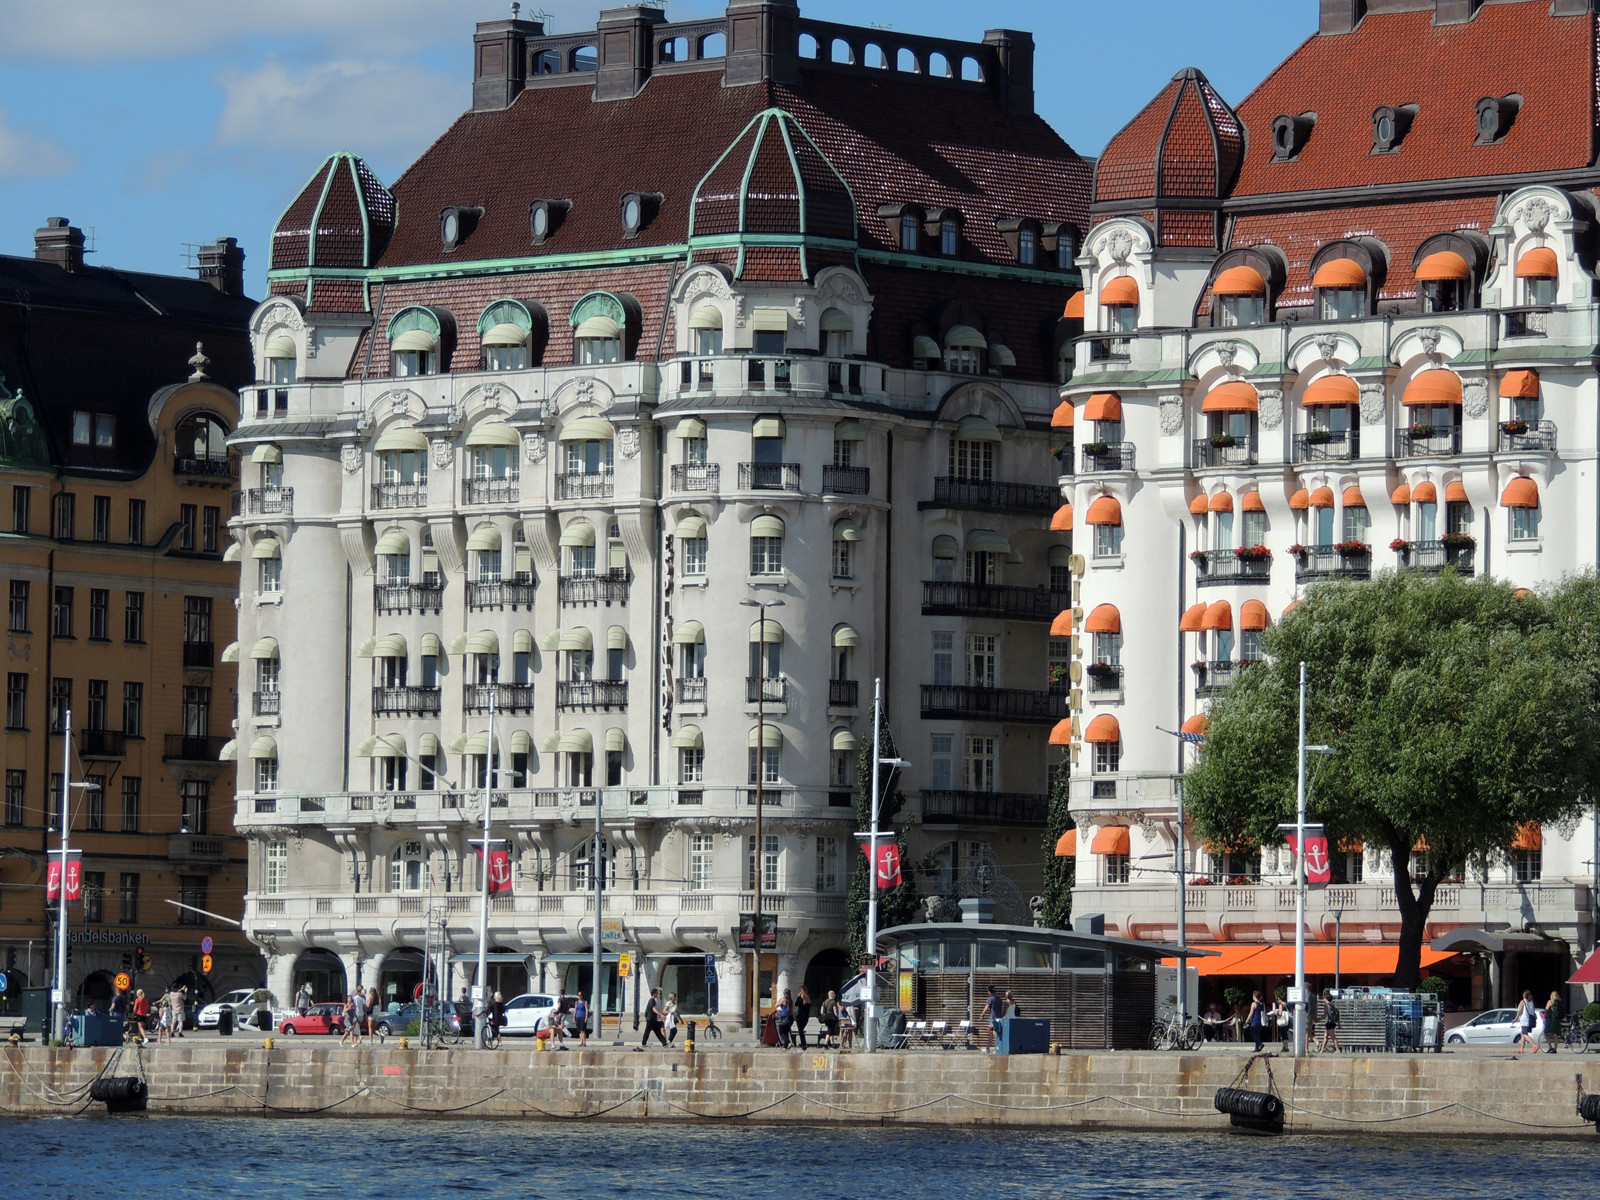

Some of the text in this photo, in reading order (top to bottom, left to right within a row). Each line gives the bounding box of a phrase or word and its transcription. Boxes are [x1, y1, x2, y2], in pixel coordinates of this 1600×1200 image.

[1068, 553, 1084, 763] DIPLOMAT
[601, 921, 621, 931] TRAND
[601, 931, 621, 940] LINIKEN
[706, 955, 713, 965] P
[117, 977, 128, 986] 50
